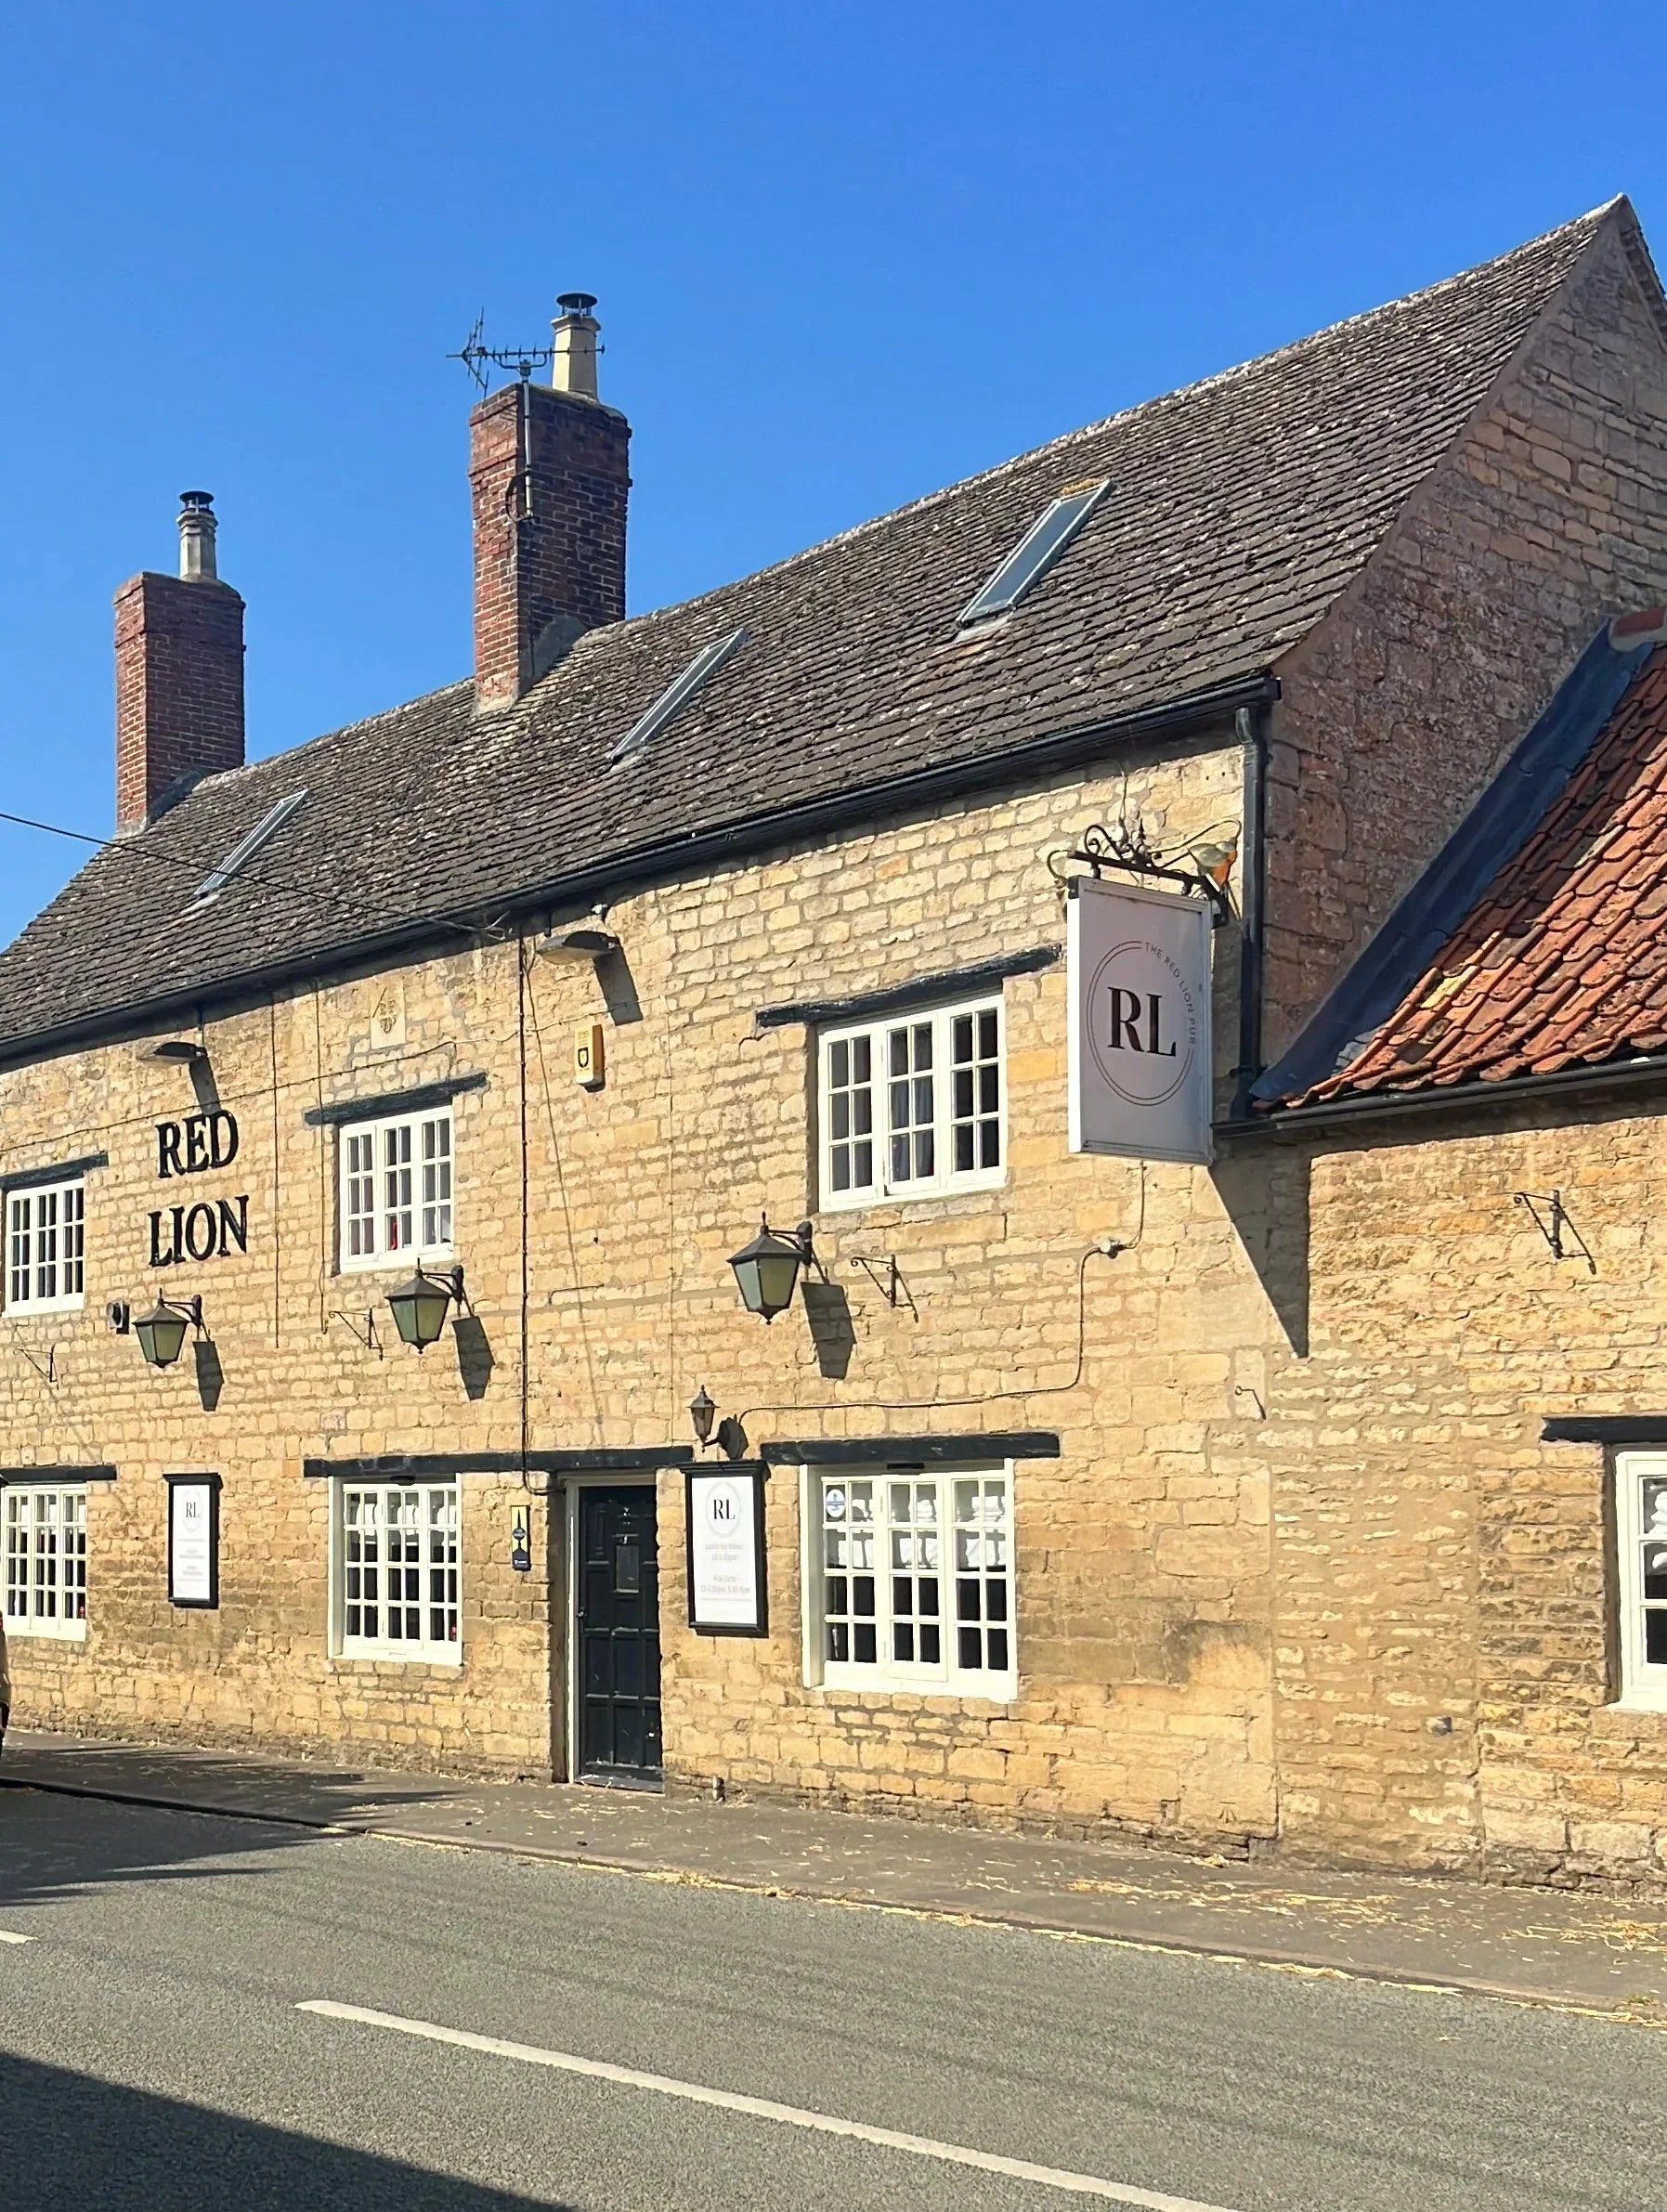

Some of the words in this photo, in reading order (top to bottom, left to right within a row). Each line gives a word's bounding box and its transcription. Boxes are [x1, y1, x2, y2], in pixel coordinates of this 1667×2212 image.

[1144, 942, 1163, 958] THE
[1164, 956, 1180, 978] RED
[1179, 980, 1194, 1013] LION
[1107, 986, 1177, 1057] RL
[155, 1109, 239, 1179] RED
[148, 1194, 249, 1268] LION
[186, 1502, 201, 1518] RL
[713, 1499, 736, 1520] RL
